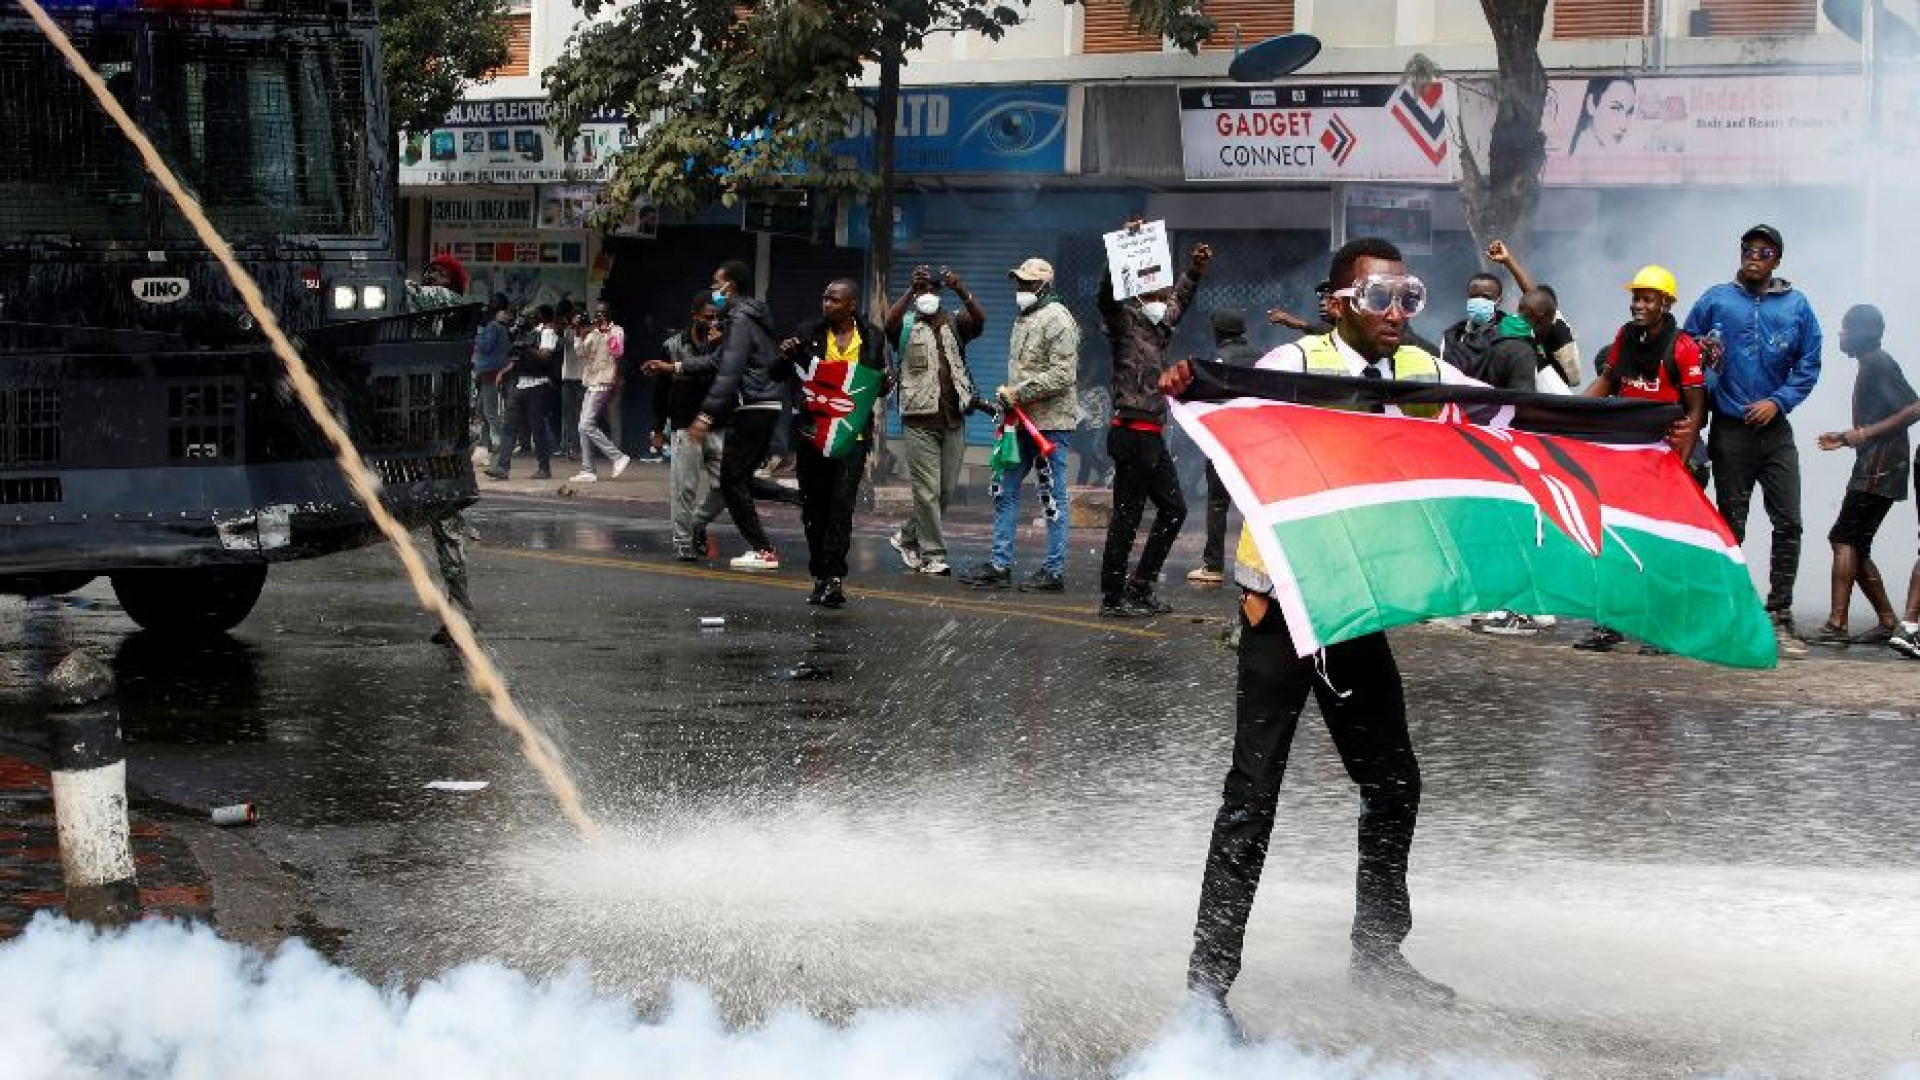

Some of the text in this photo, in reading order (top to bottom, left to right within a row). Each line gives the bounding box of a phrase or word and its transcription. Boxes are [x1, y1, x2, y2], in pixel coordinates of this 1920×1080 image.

[495, 102, 562, 121] ELECTRO
[895, 95, 950, 137] LTD
[1216, 112, 1312, 136] GADGET
[1725, 117, 1746, 129] and
[1219, 145, 1316, 166] CONNECT
[141, 281, 182, 297] JINO
